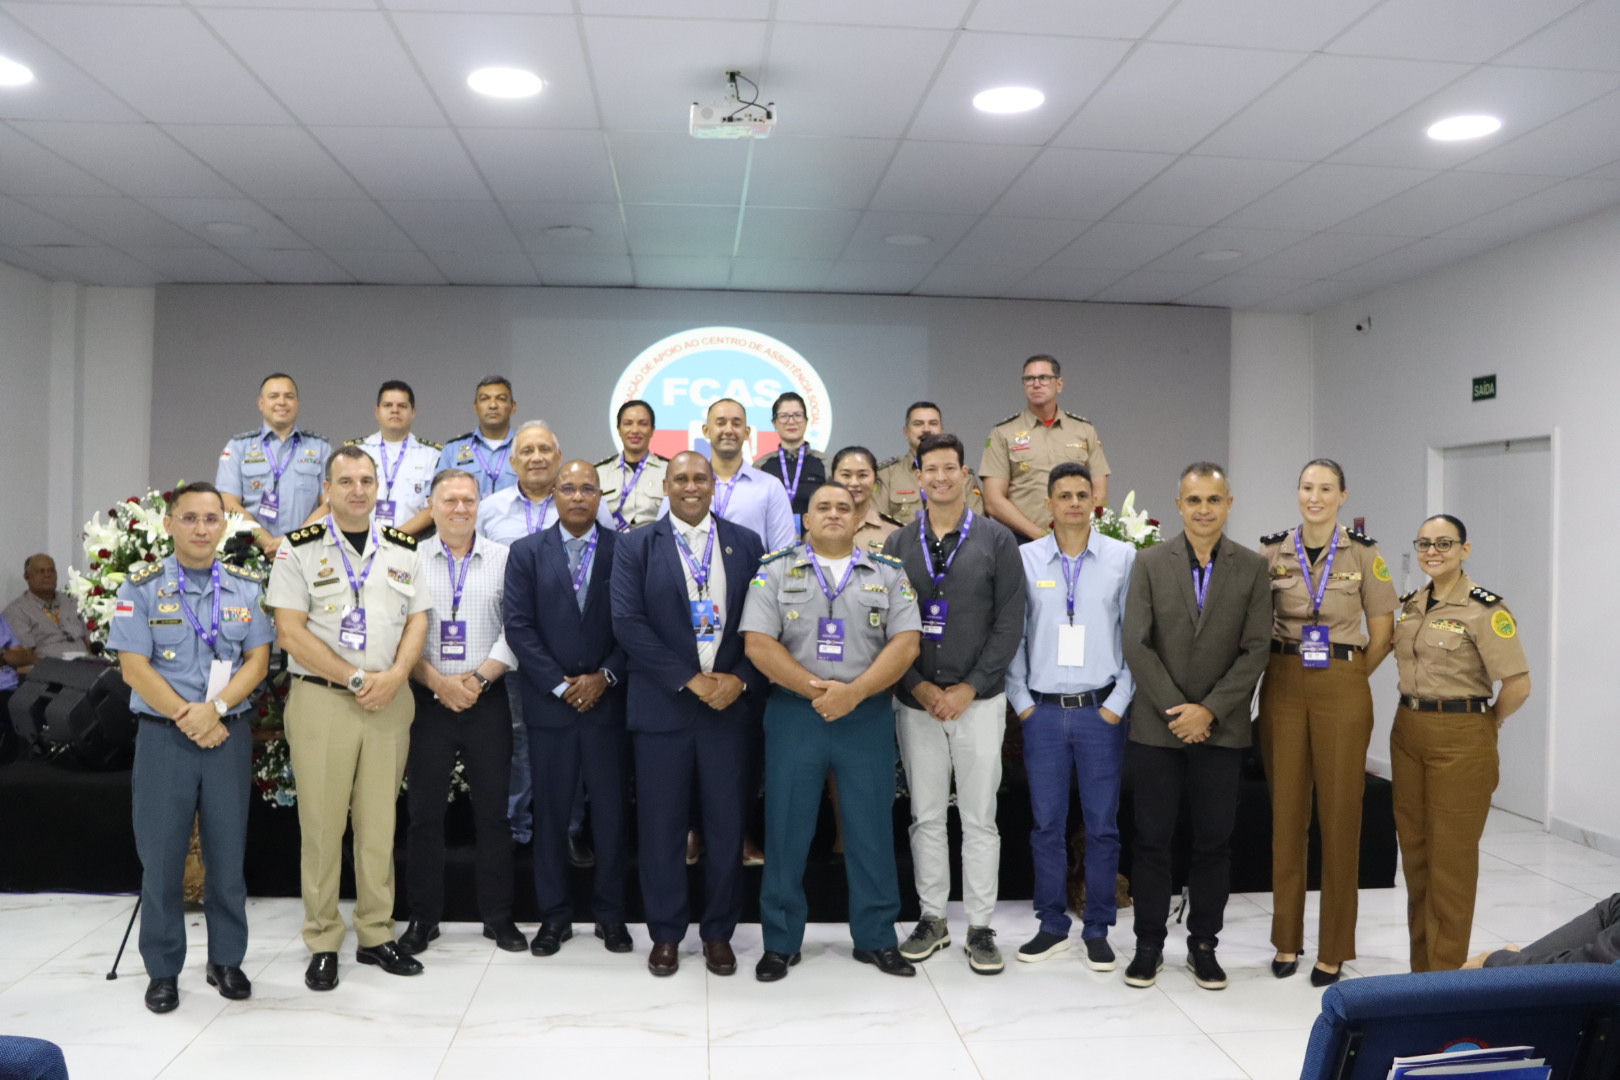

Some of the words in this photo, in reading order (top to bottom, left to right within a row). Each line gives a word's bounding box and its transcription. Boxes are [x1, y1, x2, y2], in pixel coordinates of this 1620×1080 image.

[640, 362, 655, 375] DE
[653, 344, 682, 364] APOIO
[684, 338, 700, 350] AO
[701, 336, 747, 347] CENTRO
[748, 341, 764, 352] DE
[763, 347, 813, 395] ASSISTÊNCIA
[807, 394, 820, 427] SOCIAL
[662, 378, 782, 408] FCAS
[1474, 381, 1495, 397] SAÍDA
